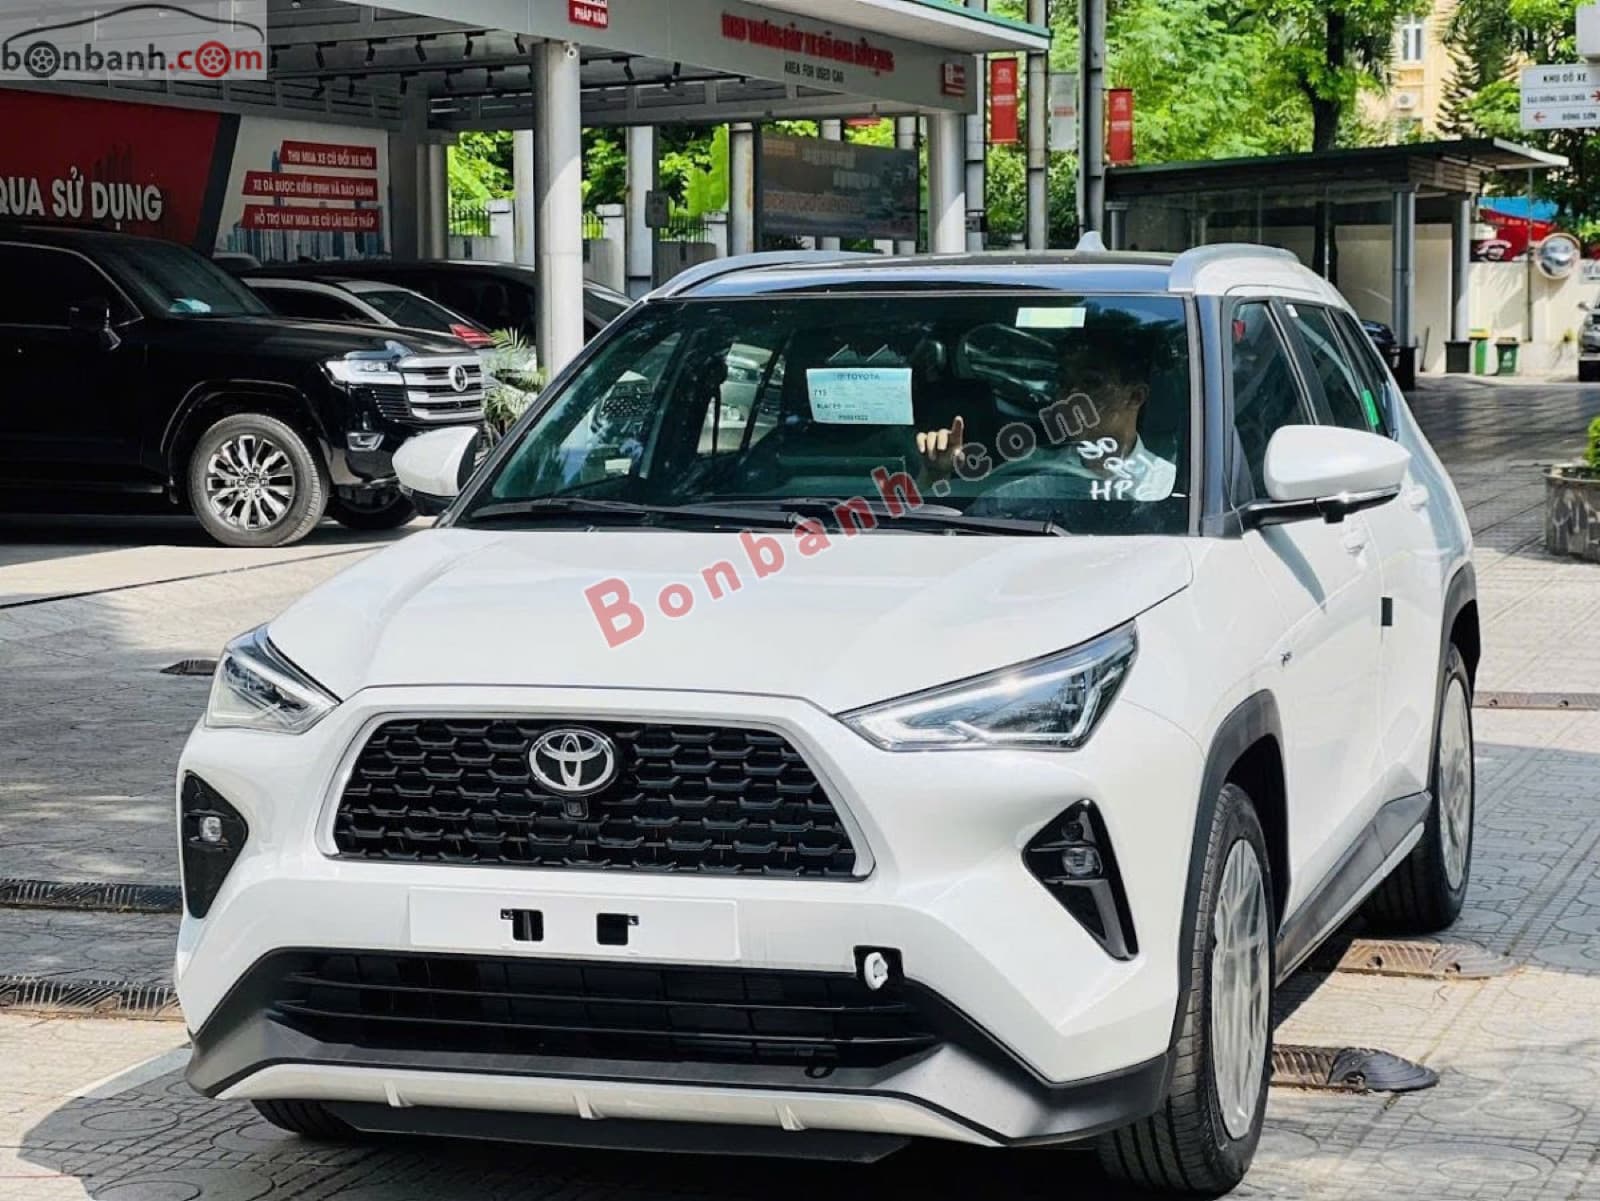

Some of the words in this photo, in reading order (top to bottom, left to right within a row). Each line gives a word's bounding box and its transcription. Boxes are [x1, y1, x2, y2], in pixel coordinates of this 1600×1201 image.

[784, 61, 800, 74] AREA
[802, 64, 814, 78] FOR
[815, 66, 830, 81] USED
[832, 69, 844, 83] CAR
[52, 165, 84, 218] SỬ
[91, 181, 162, 231] DỤNG
[847, 373, 881, 381] TOYOTA
